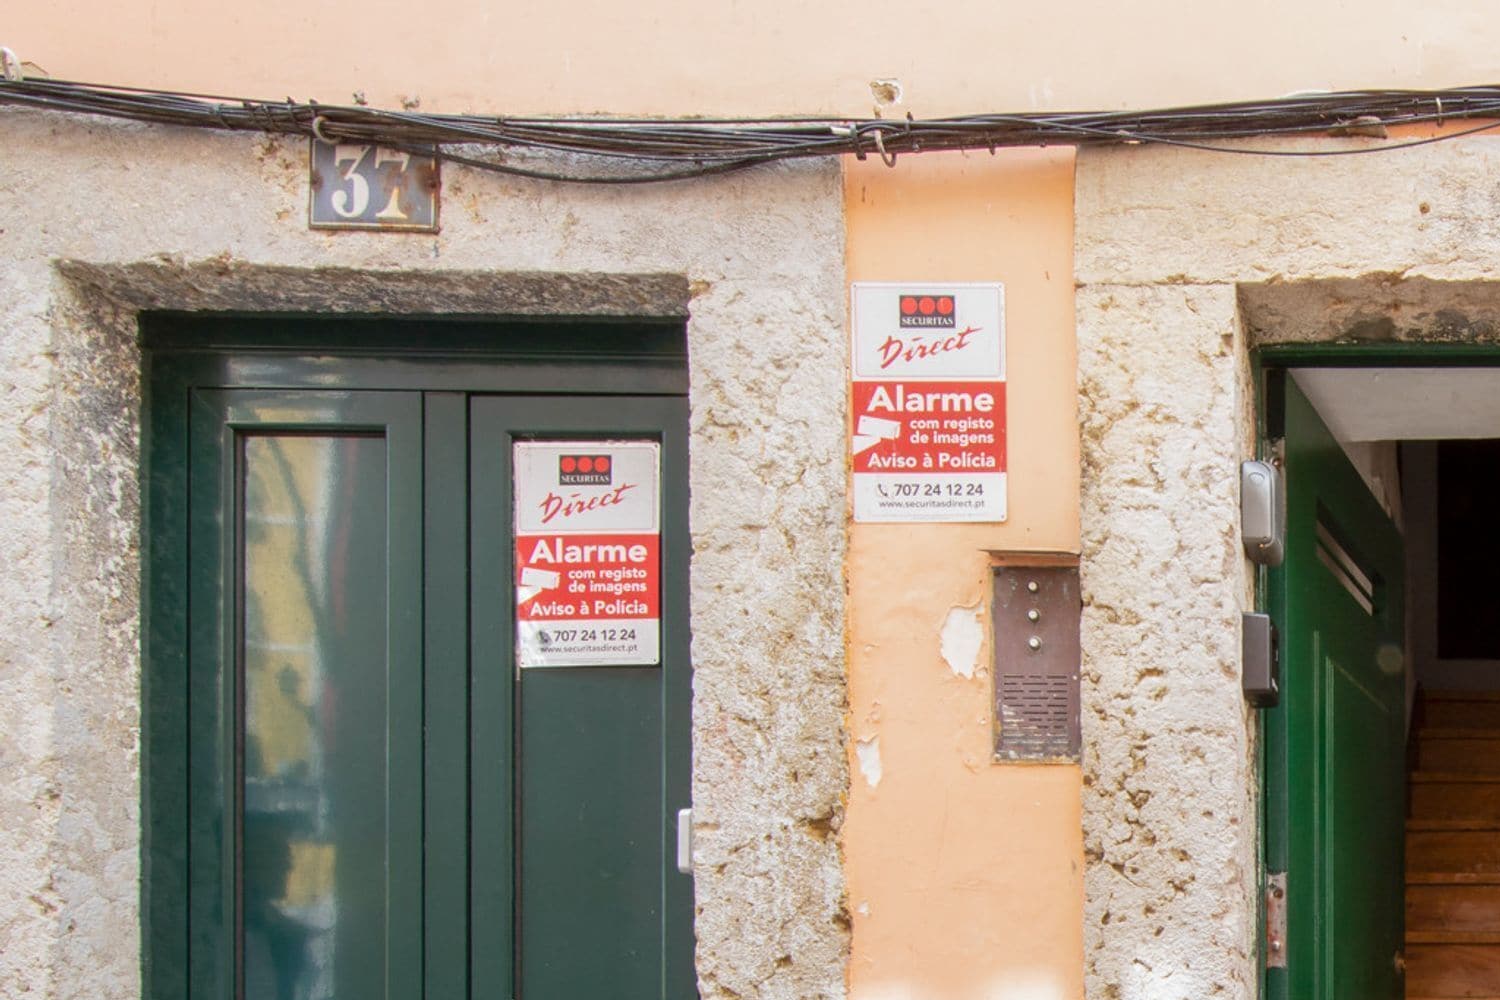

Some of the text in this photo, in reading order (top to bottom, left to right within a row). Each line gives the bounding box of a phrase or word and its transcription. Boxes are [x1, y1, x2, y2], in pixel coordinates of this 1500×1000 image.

[331, 144, 411, 220] 37
[901, 316, 954, 326] SECURITAS
[877, 326, 983, 369] Direct
[867, 384, 995, 412] Alarme
[910, 417, 994, 432] com registo
[910, 432, 994, 447] de imagens
[868, 453, 996, 468] Aviso à Polícia
[561, 475, 610, 484] SECURITAS
[894, 484, 983, 496] 707 24 12 24
[539, 483, 637, 524] Direct
[879, 499, 985, 509] www.securitasdirect.pt
[529, 538, 648, 564] Alarme
[568, 567, 647, 582] com registo
[568, 580, 647, 595] de imagens
[530, 600, 648, 616] Aviso à Polícia
[554, 629, 636, 642] 707 24 12 24
[540, 644, 637, 654] www.securitasdirect.pt
